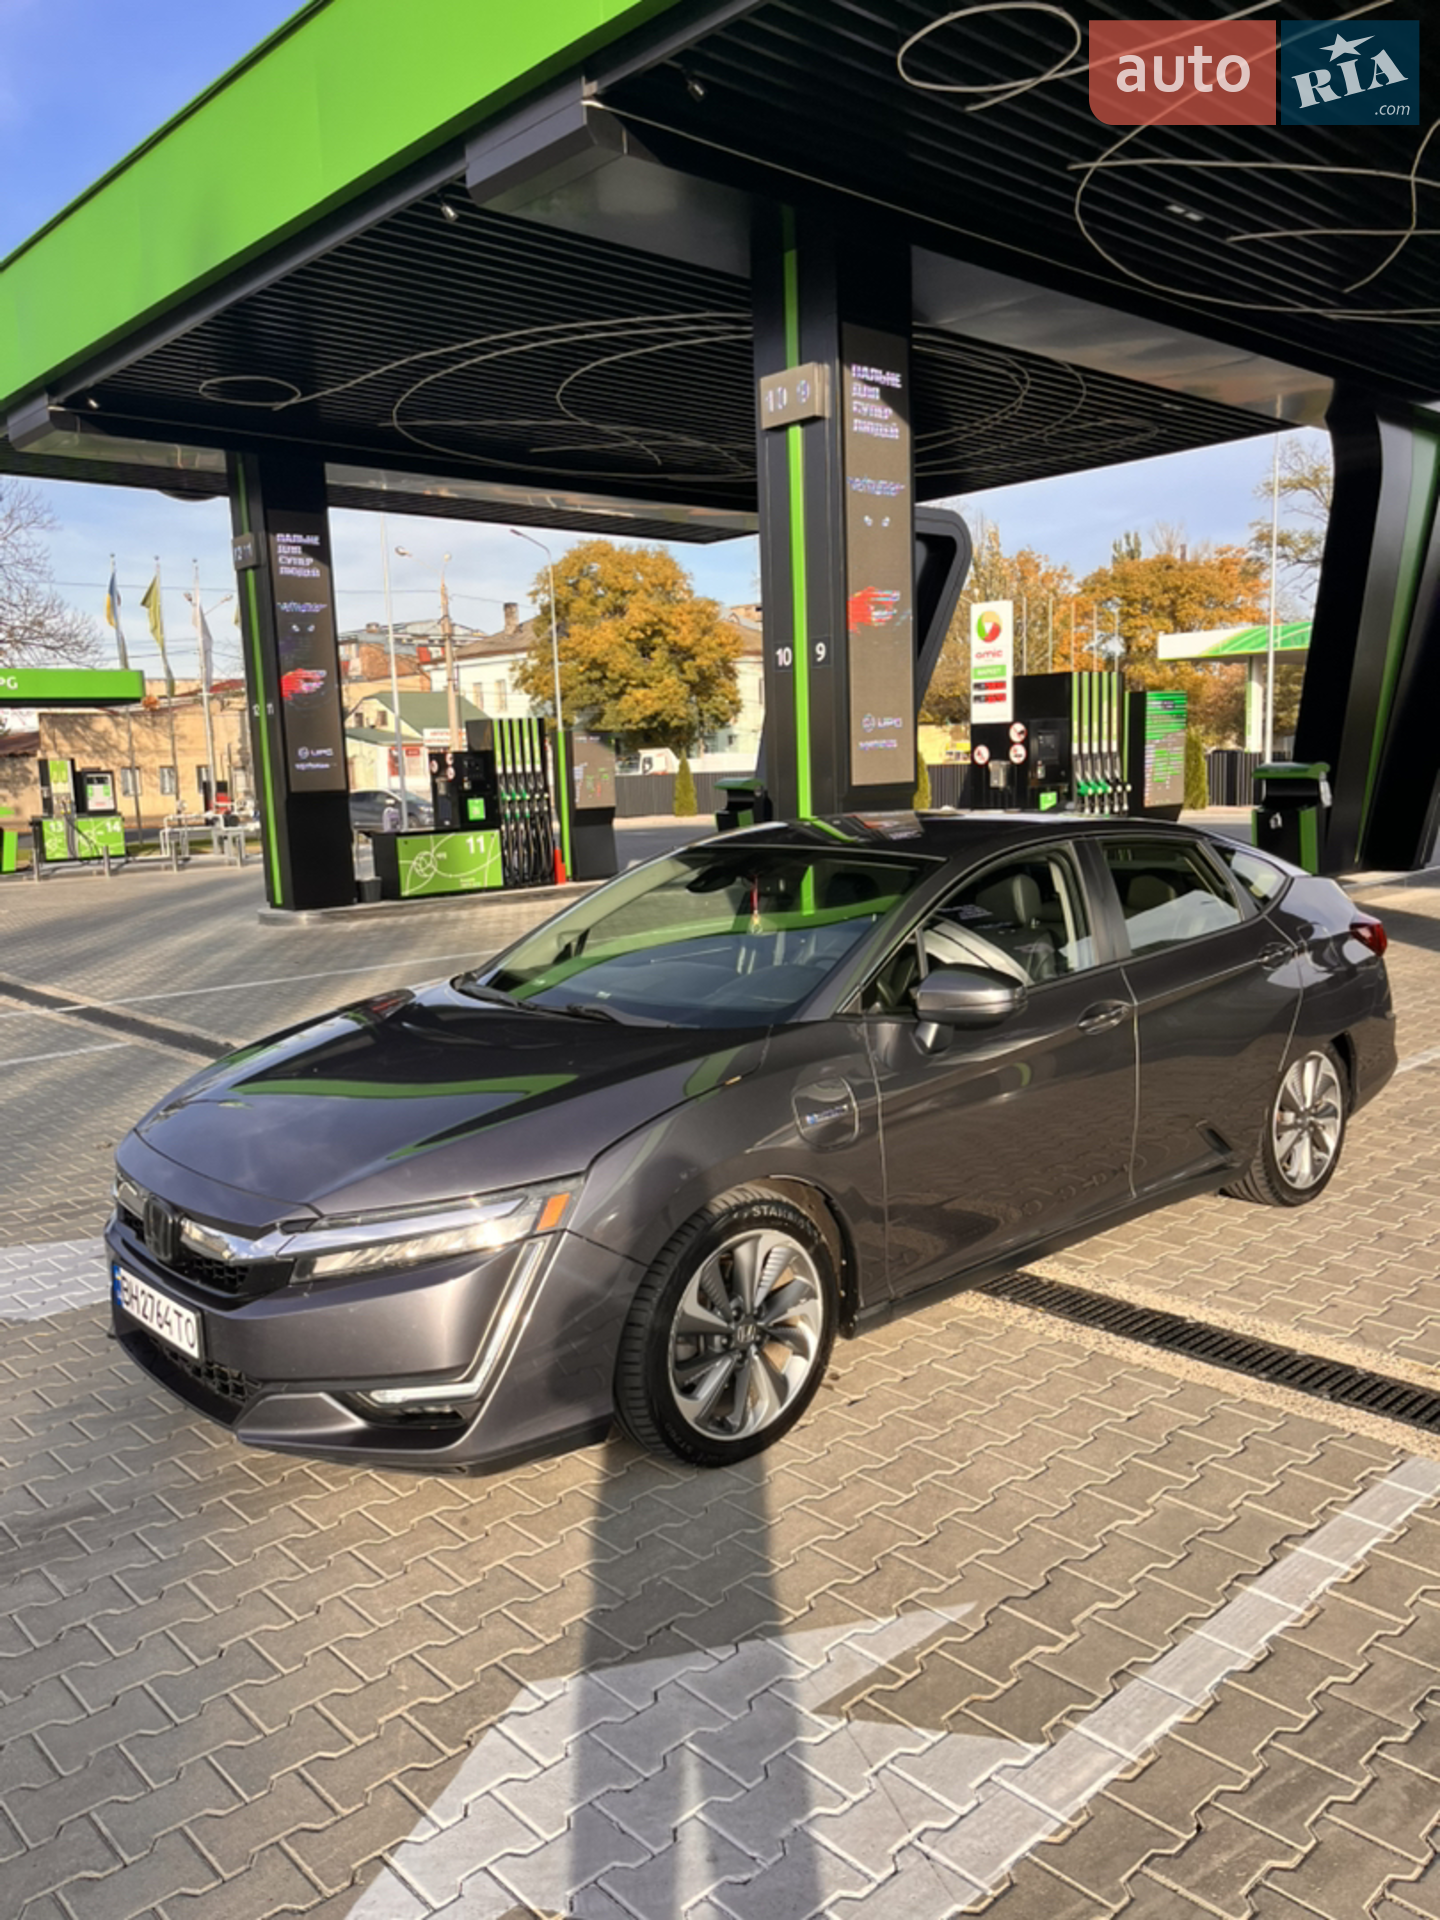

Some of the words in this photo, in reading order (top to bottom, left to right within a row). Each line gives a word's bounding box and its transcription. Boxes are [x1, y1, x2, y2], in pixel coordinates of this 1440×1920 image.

[776, 646, 792, 667] 10
[815, 642, 826, 662] 9
[106, 820, 122, 832] 14
[466, 835, 485, 854] 11
